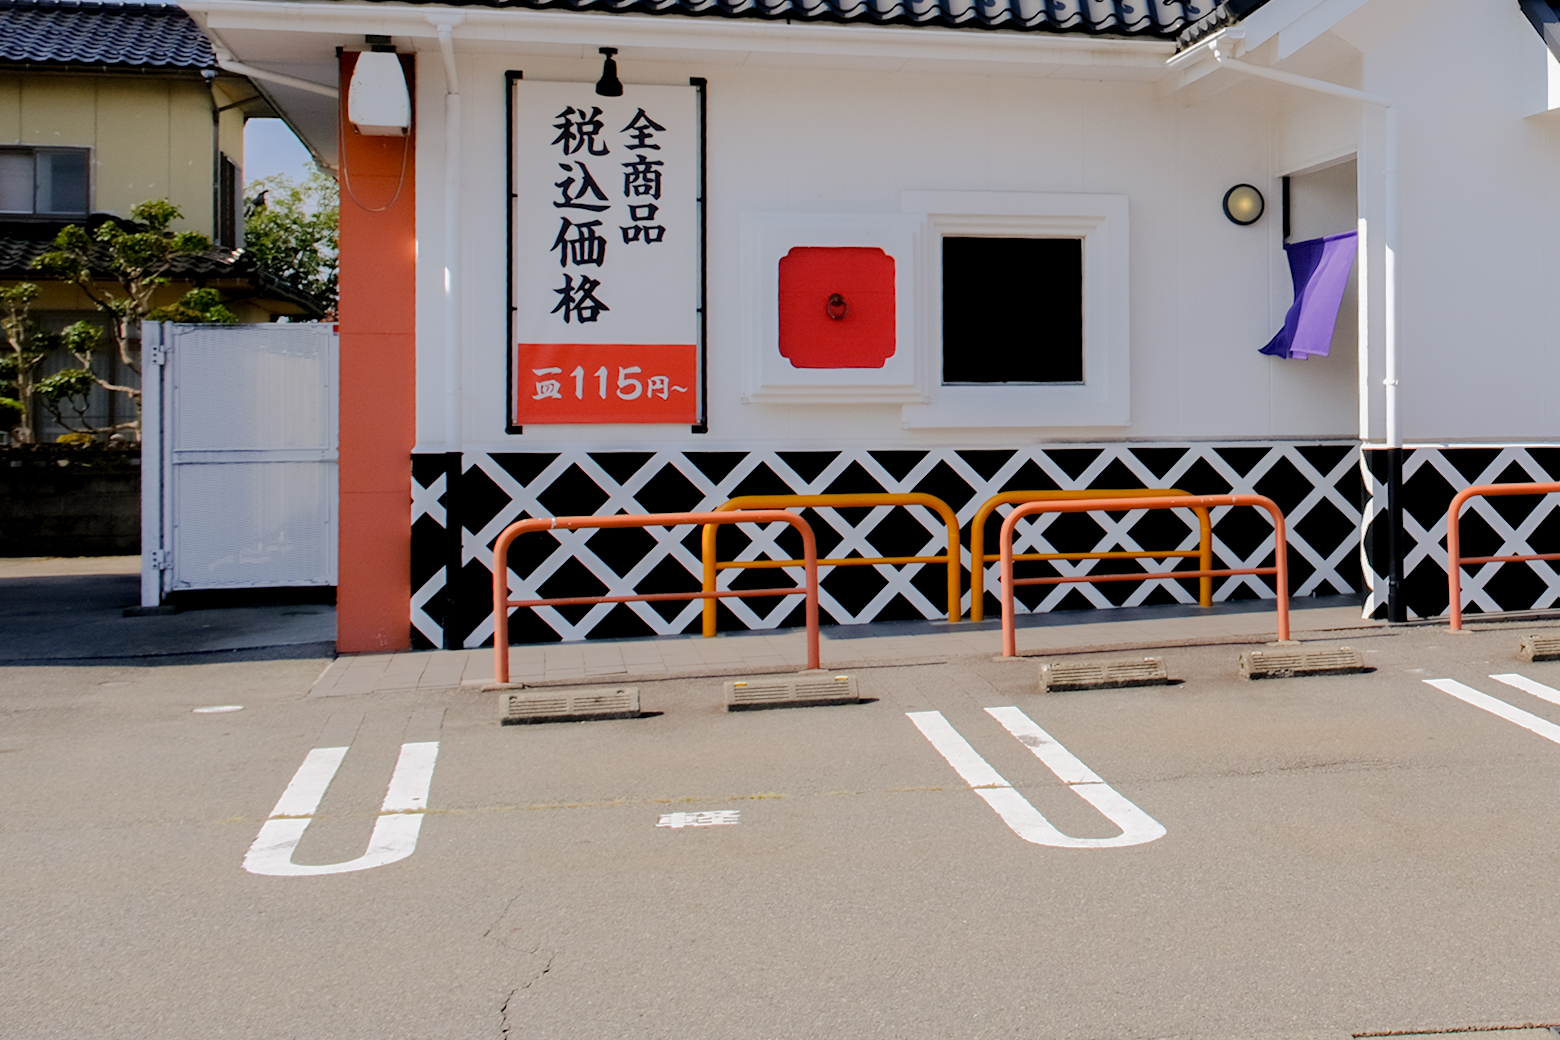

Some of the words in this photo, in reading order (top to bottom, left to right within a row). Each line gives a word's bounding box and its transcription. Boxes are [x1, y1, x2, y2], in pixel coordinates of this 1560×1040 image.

[550, 105, 611, 324] 税込価格
[619, 107, 667, 245] 全商品
